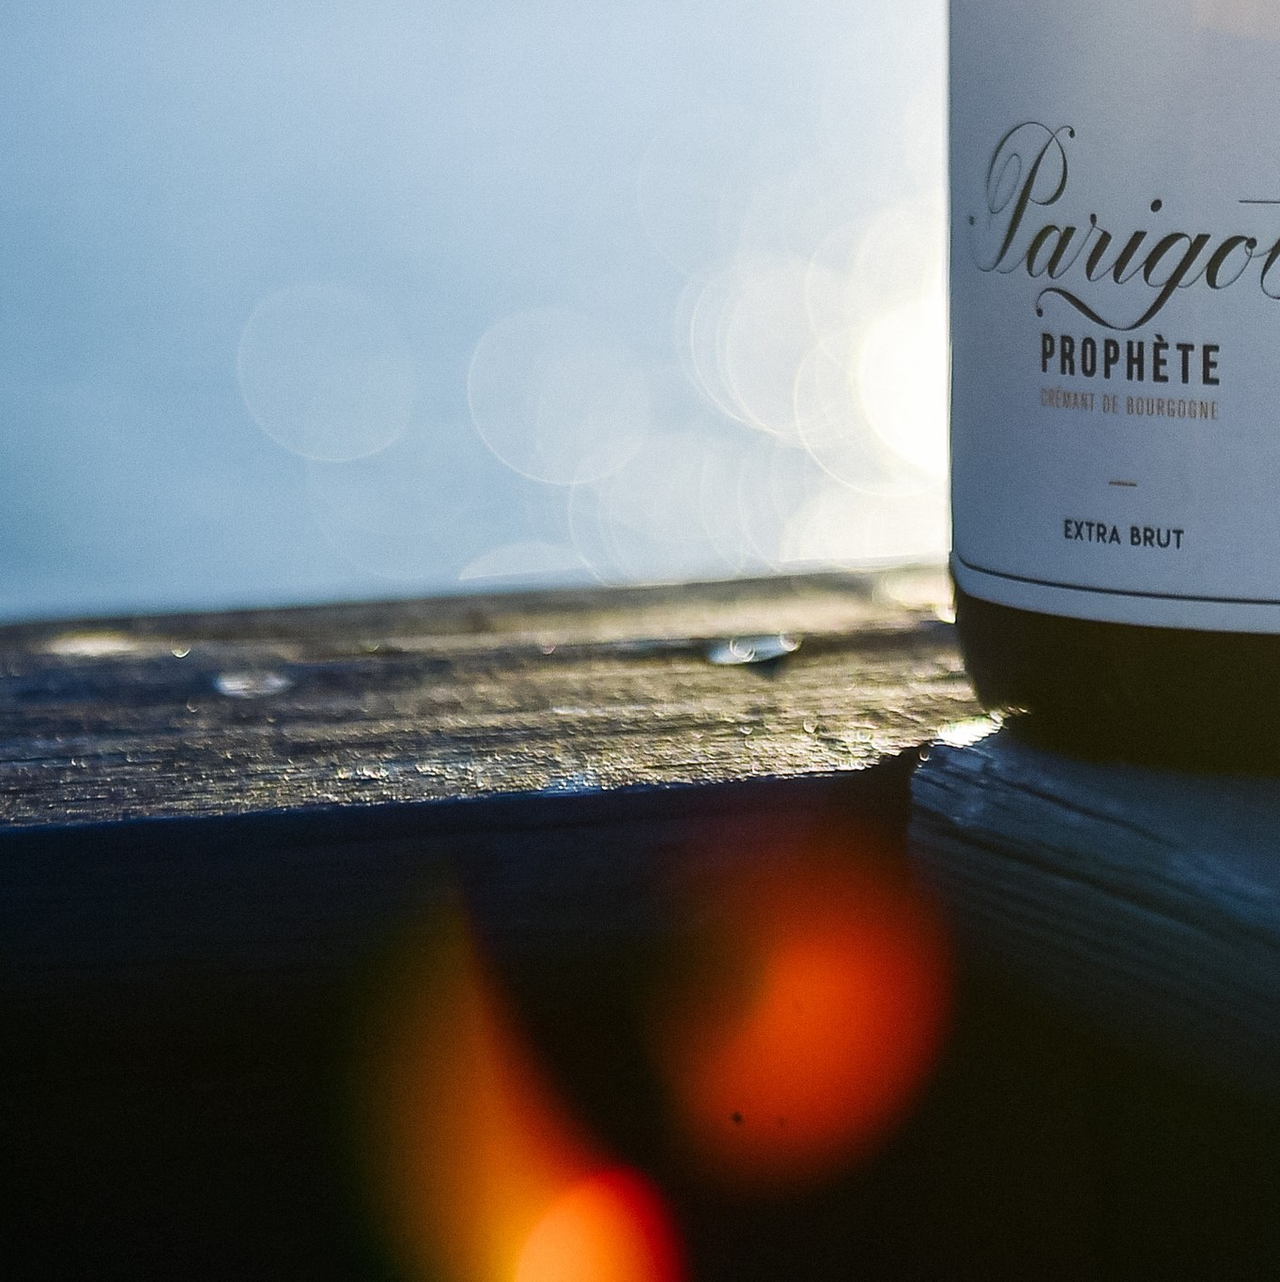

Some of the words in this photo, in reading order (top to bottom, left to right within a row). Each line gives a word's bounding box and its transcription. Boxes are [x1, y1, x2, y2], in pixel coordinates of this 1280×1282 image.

[1041, 332, 1220, 386] PROPHÈTE
[1102, 393, 1119, 415] DE
[1126, 395, 1219, 421] BOURGOGNE
[1063, 519, 1121, 545] EXTRA
[1130, 525, 1185, 550] BRUT
